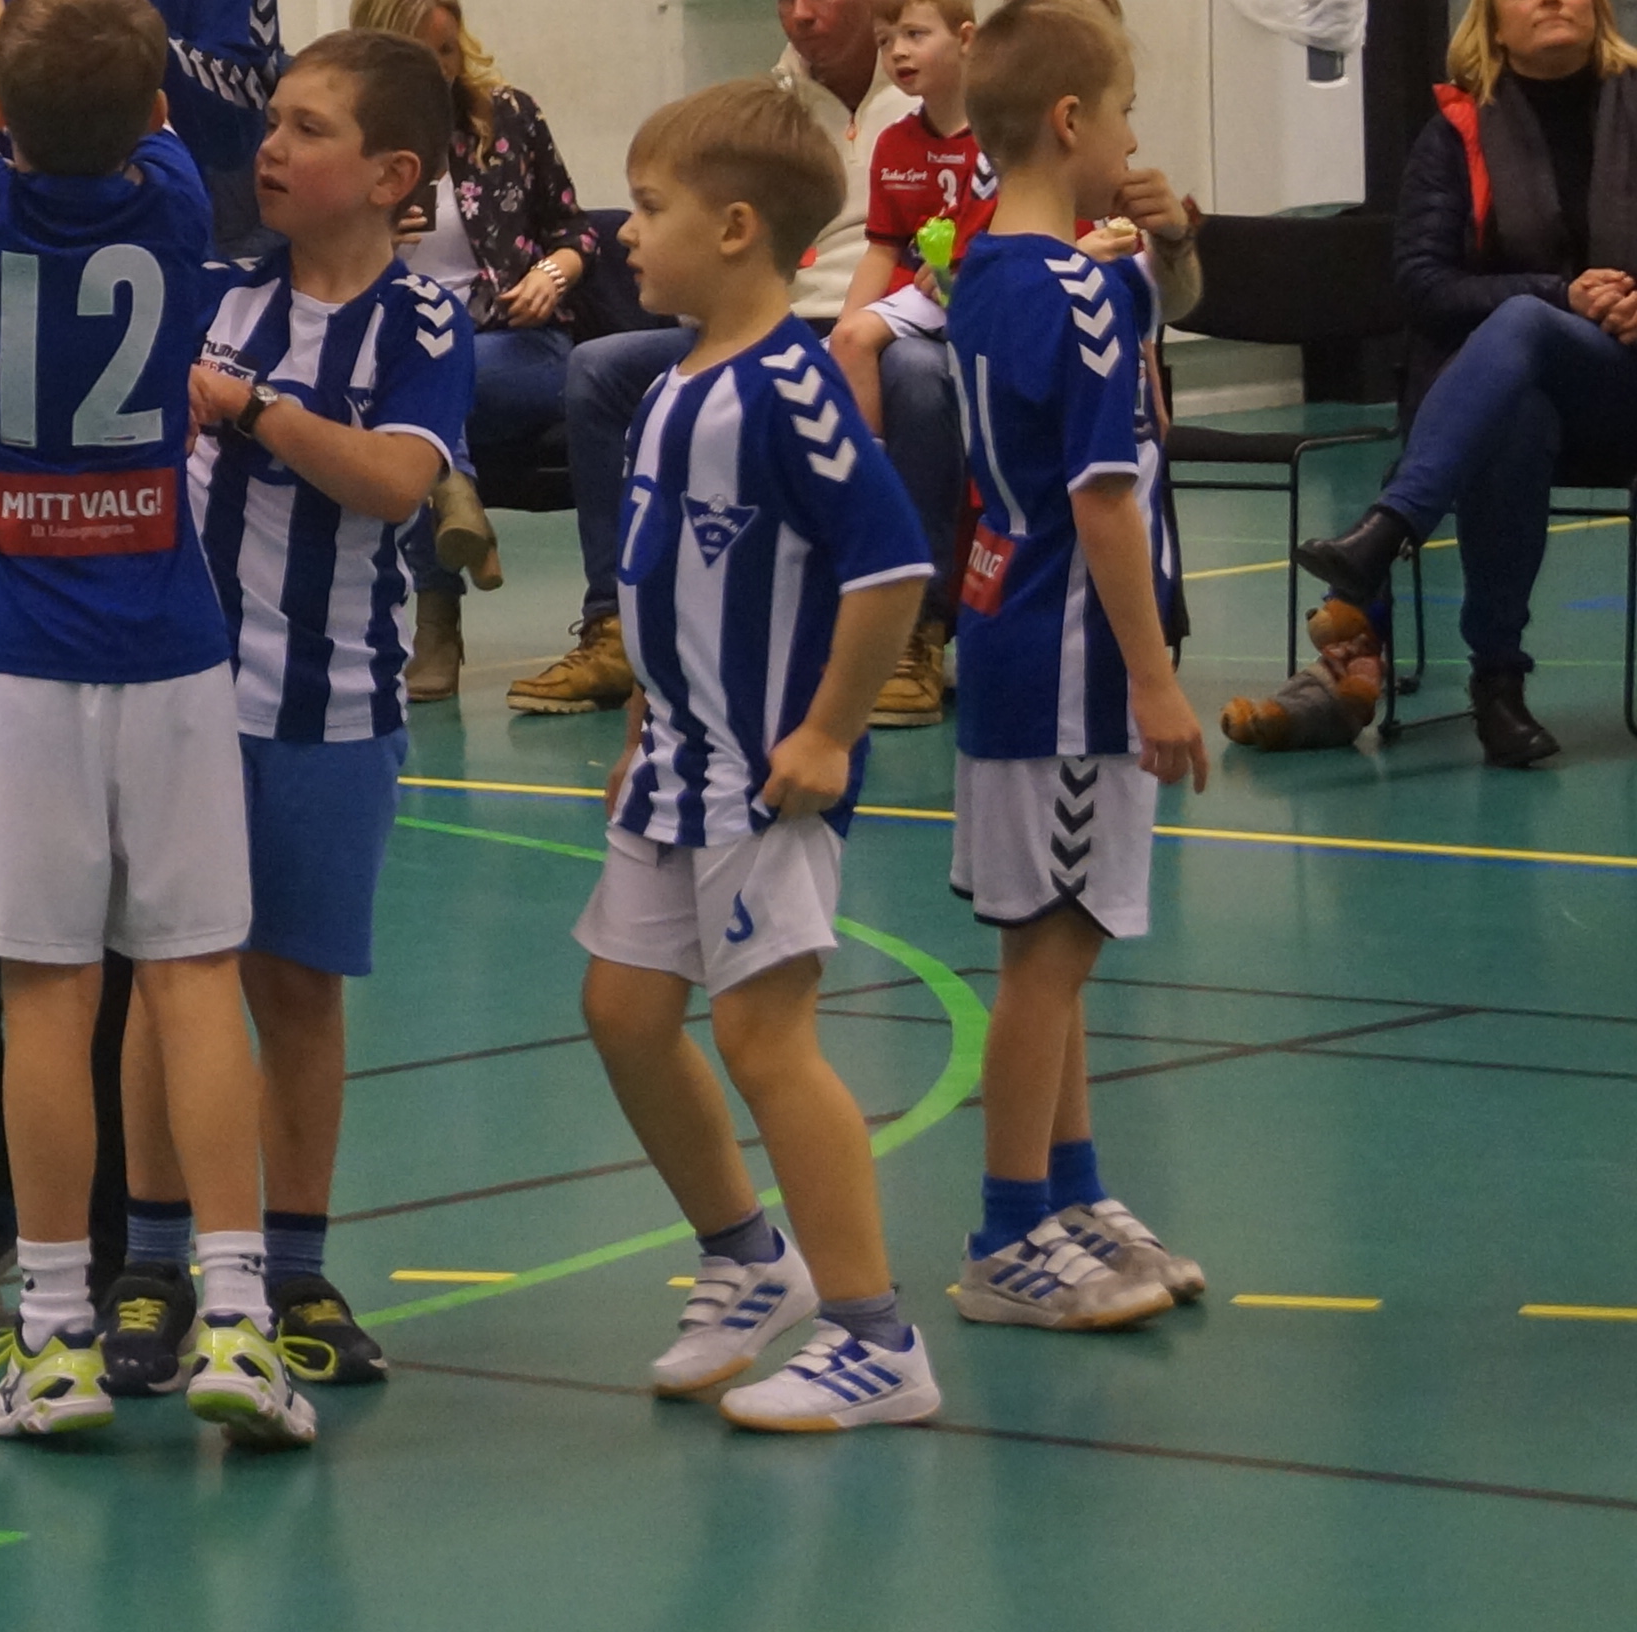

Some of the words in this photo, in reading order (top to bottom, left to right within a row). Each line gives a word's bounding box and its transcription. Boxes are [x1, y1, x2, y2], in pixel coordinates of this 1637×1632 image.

[1, 491, 75, 520] MITT
[79, 487, 162, 519] VALG!
[621, 485, 652, 572] 7
